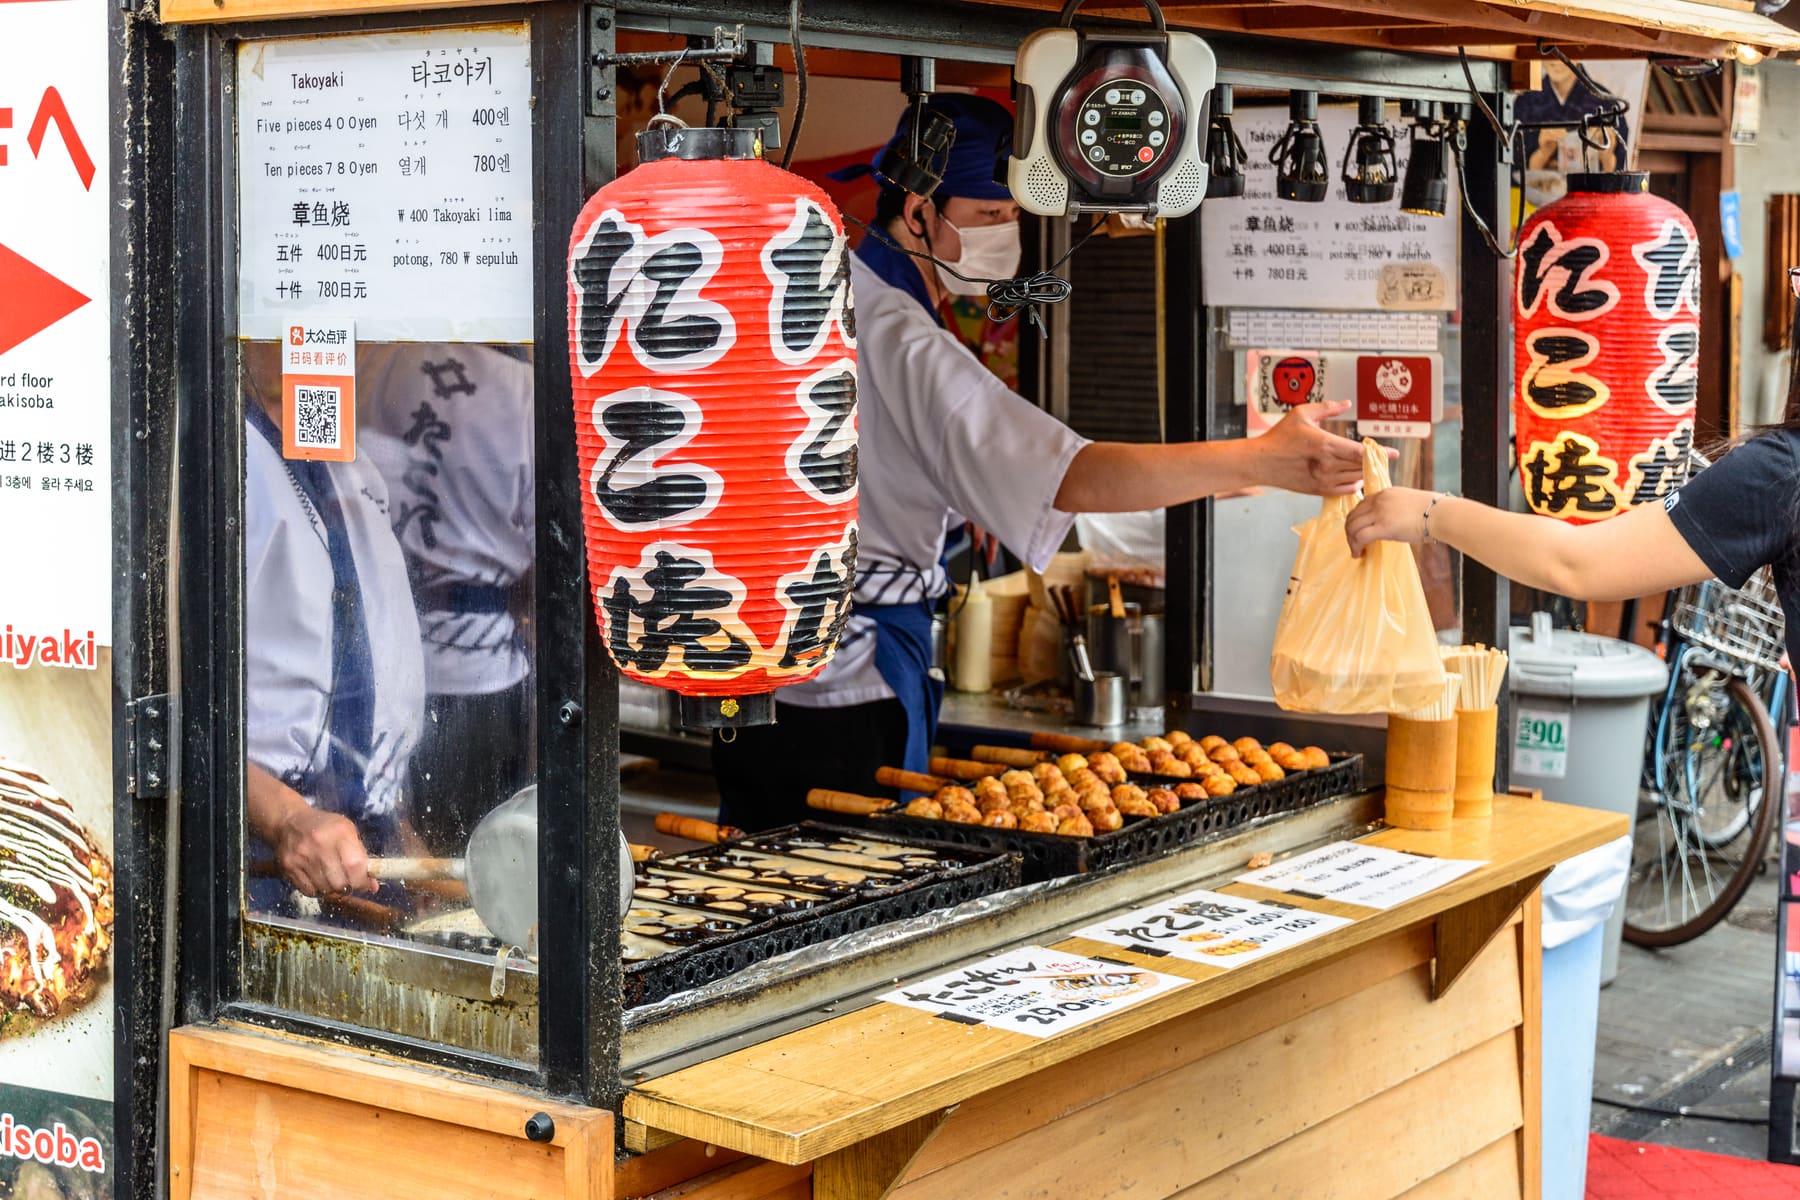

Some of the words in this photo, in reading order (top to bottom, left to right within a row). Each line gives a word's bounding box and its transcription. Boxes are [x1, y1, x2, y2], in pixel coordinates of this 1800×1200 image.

[291, 71, 344, 90] Takoyaki
[411, 56, 493, 88] 타코야키
[256, 118, 281, 133] Five
[398, 109, 426, 131] 다섯
[434, 109, 448, 129] 개
[472, 106, 510, 126] 400엔
[264, 162, 282, 177] Ten
[398, 155, 427, 176] 열개
[473, 153, 511, 173] 780엔
[292, 200, 350, 227] 章鱼烧
[410, 208, 428, 223] 400
[433, 207, 480, 224] Takoyaki
[489, 207, 512, 221] lima
[1245, 215, 1294, 233] 章鱼烧
[276, 244, 303, 262] 五件
[317, 243, 367, 261] 400日元
[393, 253, 433, 267] potong,
[440, 252, 458, 265] 780
[476, 251, 518, 267] sepuluh
[1232, 243, 1254, 256] 五件
[1267, 243, 1308, 257] 400日元
[1232, 267, 1254, 280] 十件
[1268, 267, 1308, 280] 780日元
[276, 281, 303, 299] 十件
[317, 281, 367, 298] 780日元
[305, 328, 347, 345] 大众点评
[290, 352, 347, 366] 扫码看评价
[21, 373, 54, 388] floor
[5, 475, 31, 489] 3층에
[41, 476, 61, 491] 올라
[0, 624, 94, 666] iyaki
[1532, 719, 1562, 744] 90
[1106, 900, 1248, 942] たこ焼
[902, 962, 1037, 1007] たこせん
[1015, 999, 1105, 1025] 290円
